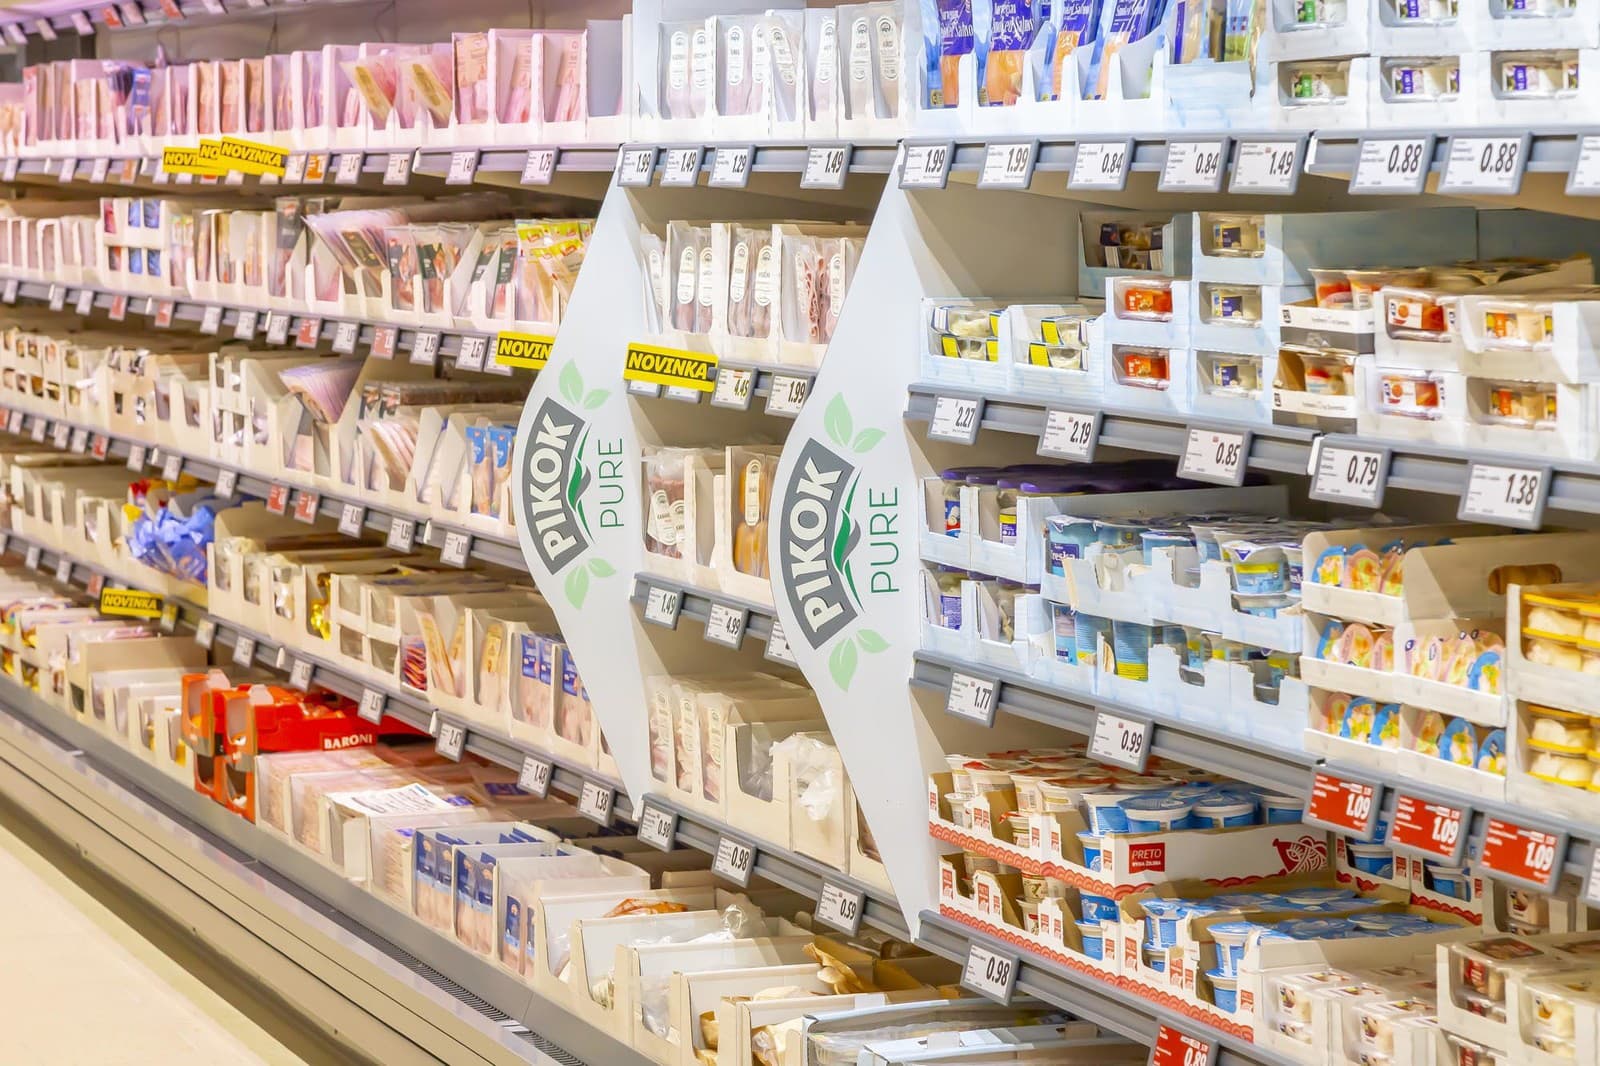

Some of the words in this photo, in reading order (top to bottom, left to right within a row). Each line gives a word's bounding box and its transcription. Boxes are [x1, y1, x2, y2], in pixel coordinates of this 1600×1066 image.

[164, 152, 197, 167] NOVI
[221, 142, 282, 168] NOVINKA
[680, 150, 697, 173] 1.49
[731, 154, 747, 174] 1.29
[824, 150, 843, 174] 1.49
[924, 148, 946, 174] 1.99
[1006, 147, 1029, 173] 1.99
[1101, 152, 1123, 174] 0.84
[1195, 152, 1218, 175] 0.84
[1268, 151, 1294, 176] 1.49
[1387, 143, 1423, 174] 0.88
[1480, 142, 1518, 174] 0.88
[499, 339, 553, 360] NOVIN
[628, 351, 708, 380] NOVINKA
[733, 378, 749, 398] 4.45
[788, 380, 807, 404] 1.99
[955, 406, 976, 429] 2.27
[1070, 421, 1092, 444] 2.19
[1215, 443, 1241, 467] 0.85
[1347, 454, 1379, 486] 0.79
[530, 413, 577, 562] PIKOK
[598, 437, 625, 528] PURE
[1505, 473, 1538, 505] 1.38
[790, 456, 844, 634] PIKOK
[869, 486, 900, 593] PURE
[103, 593, 158, 611] NOVINKA
[660, 595, 676, 614] 1.49
[726, 615, 741, 636] 4.99
[974, 686, 992, 709] 1.77
[323, 734, 373, 750] BARONI
[1120, 729, 1143, 754] 0.99
[595, 790, 609, 813] 1.38
[1346, 793, 1371, 821] 1.09
[1432, 816, 1459, 845] 1.09
[731, 846, 750, 872] 0.98
[1131, 848, 1162, 861] PRETO
[1525, 841, 1554, 872] 1.09
[840, 898, 857, 921] 0.59
[985, 957, 1010, 987] 0.98
